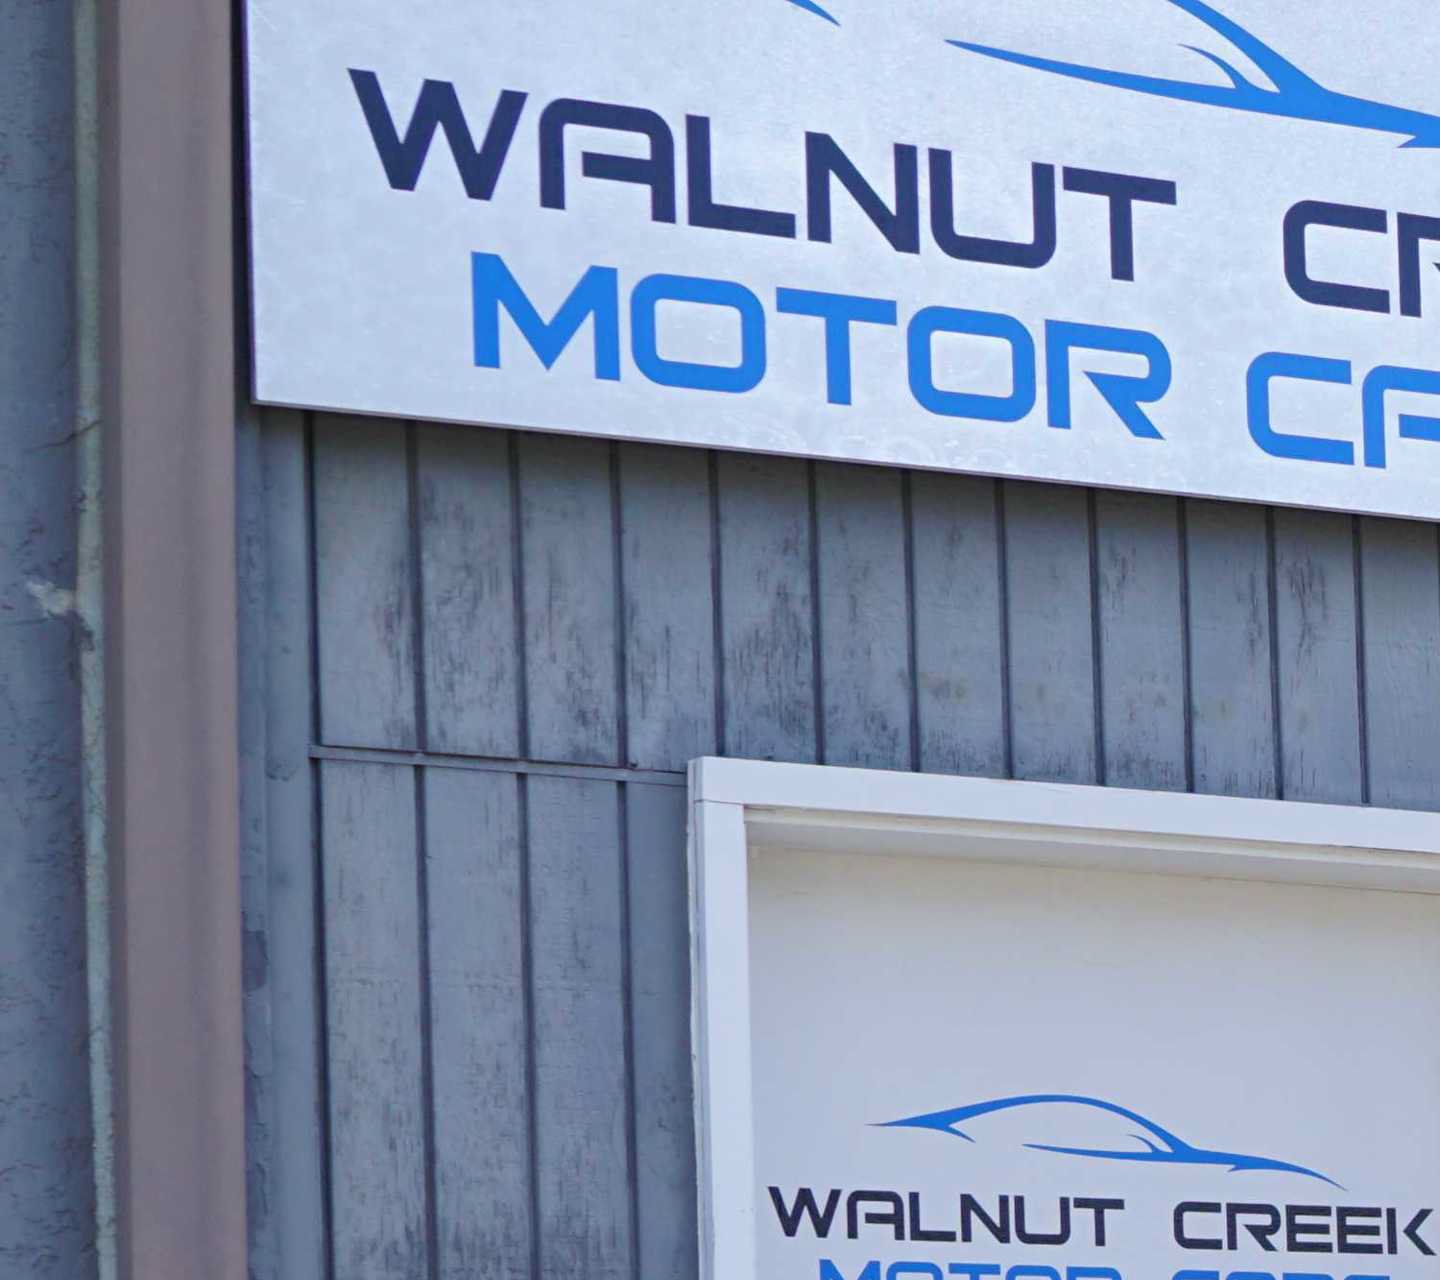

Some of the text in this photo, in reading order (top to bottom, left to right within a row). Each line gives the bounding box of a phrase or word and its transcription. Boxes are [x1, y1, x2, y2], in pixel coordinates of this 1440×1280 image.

[348, 69, 1176, 281] WALNUT
[472, 252, 1171, 439] MOTOR
[768, 1186, 1436, 1256] WALNUT CREEK
